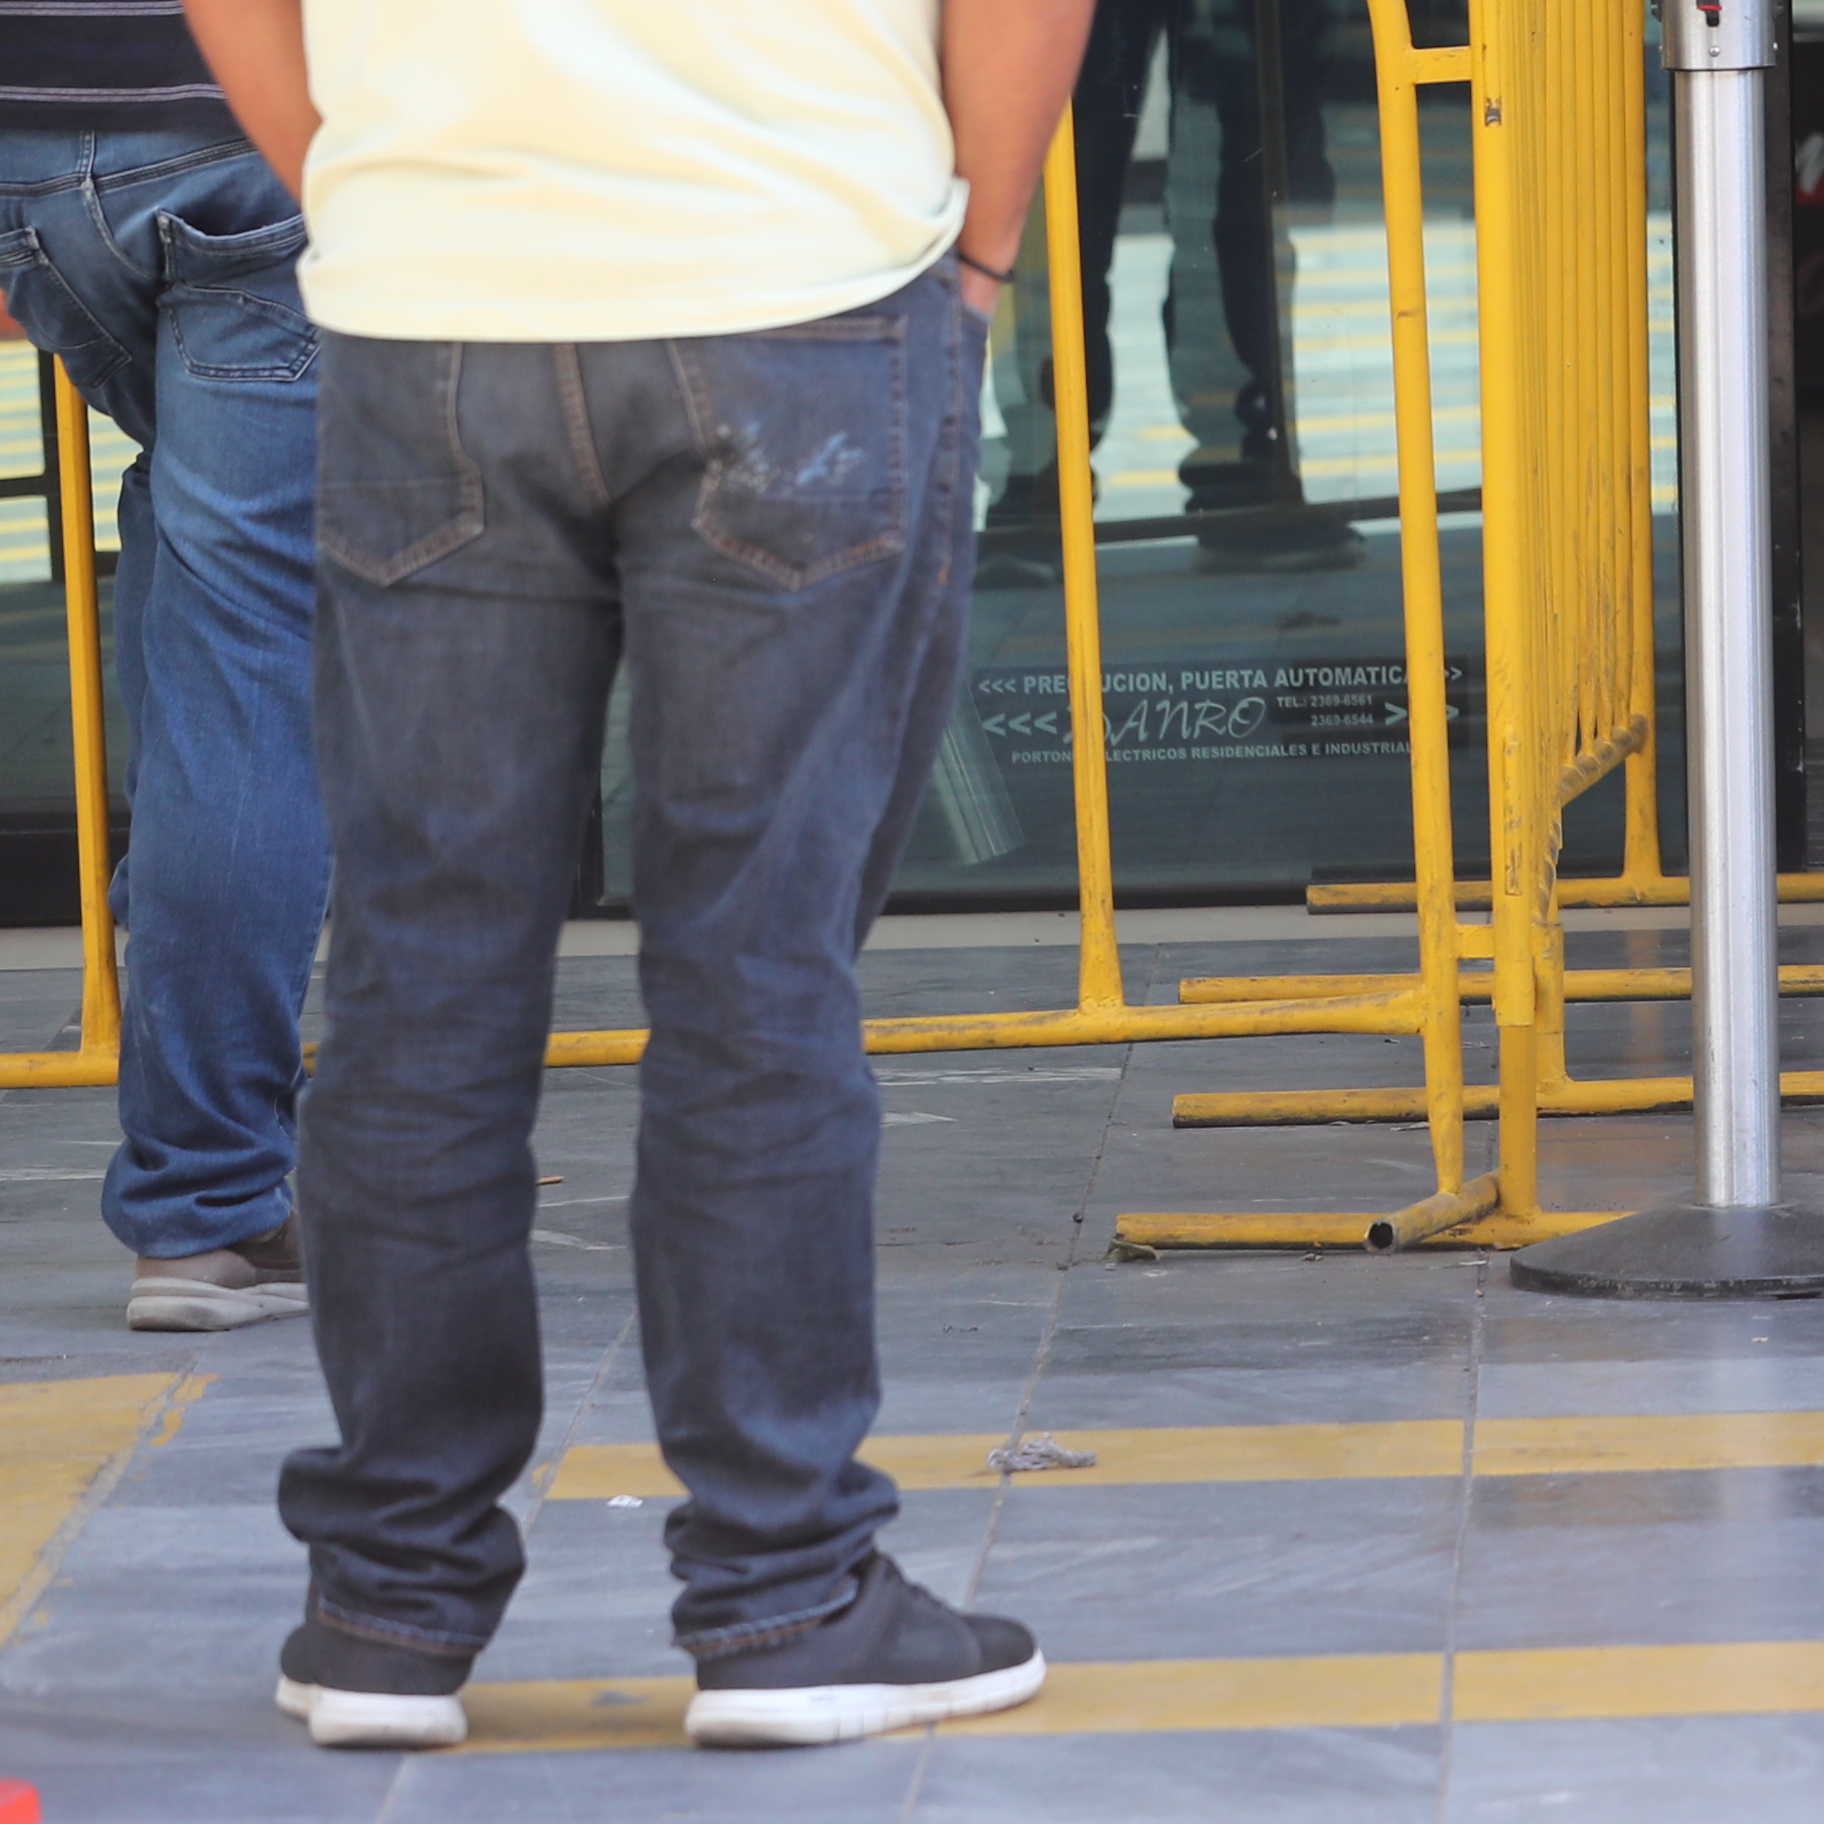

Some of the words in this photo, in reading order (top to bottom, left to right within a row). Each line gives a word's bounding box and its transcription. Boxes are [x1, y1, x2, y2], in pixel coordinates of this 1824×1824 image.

[1023, 671, 1175, 696] PREUCION,
[1181, 668, 1266, 691] PUERTA
[1310, 694, 1373, 708] 2369-6561
[1310, 712, 1374, 726] 2369-6544
[1012, 748, 1074, 764] PORTON
[1104, 747, 1187, 762] LECTRICOS
[1191, 743, 1308, 759] RESIDENCIALES
[1312, 743, 1321, 757] E
[1325, 741, 1413, 757] INDUSTRIAL
